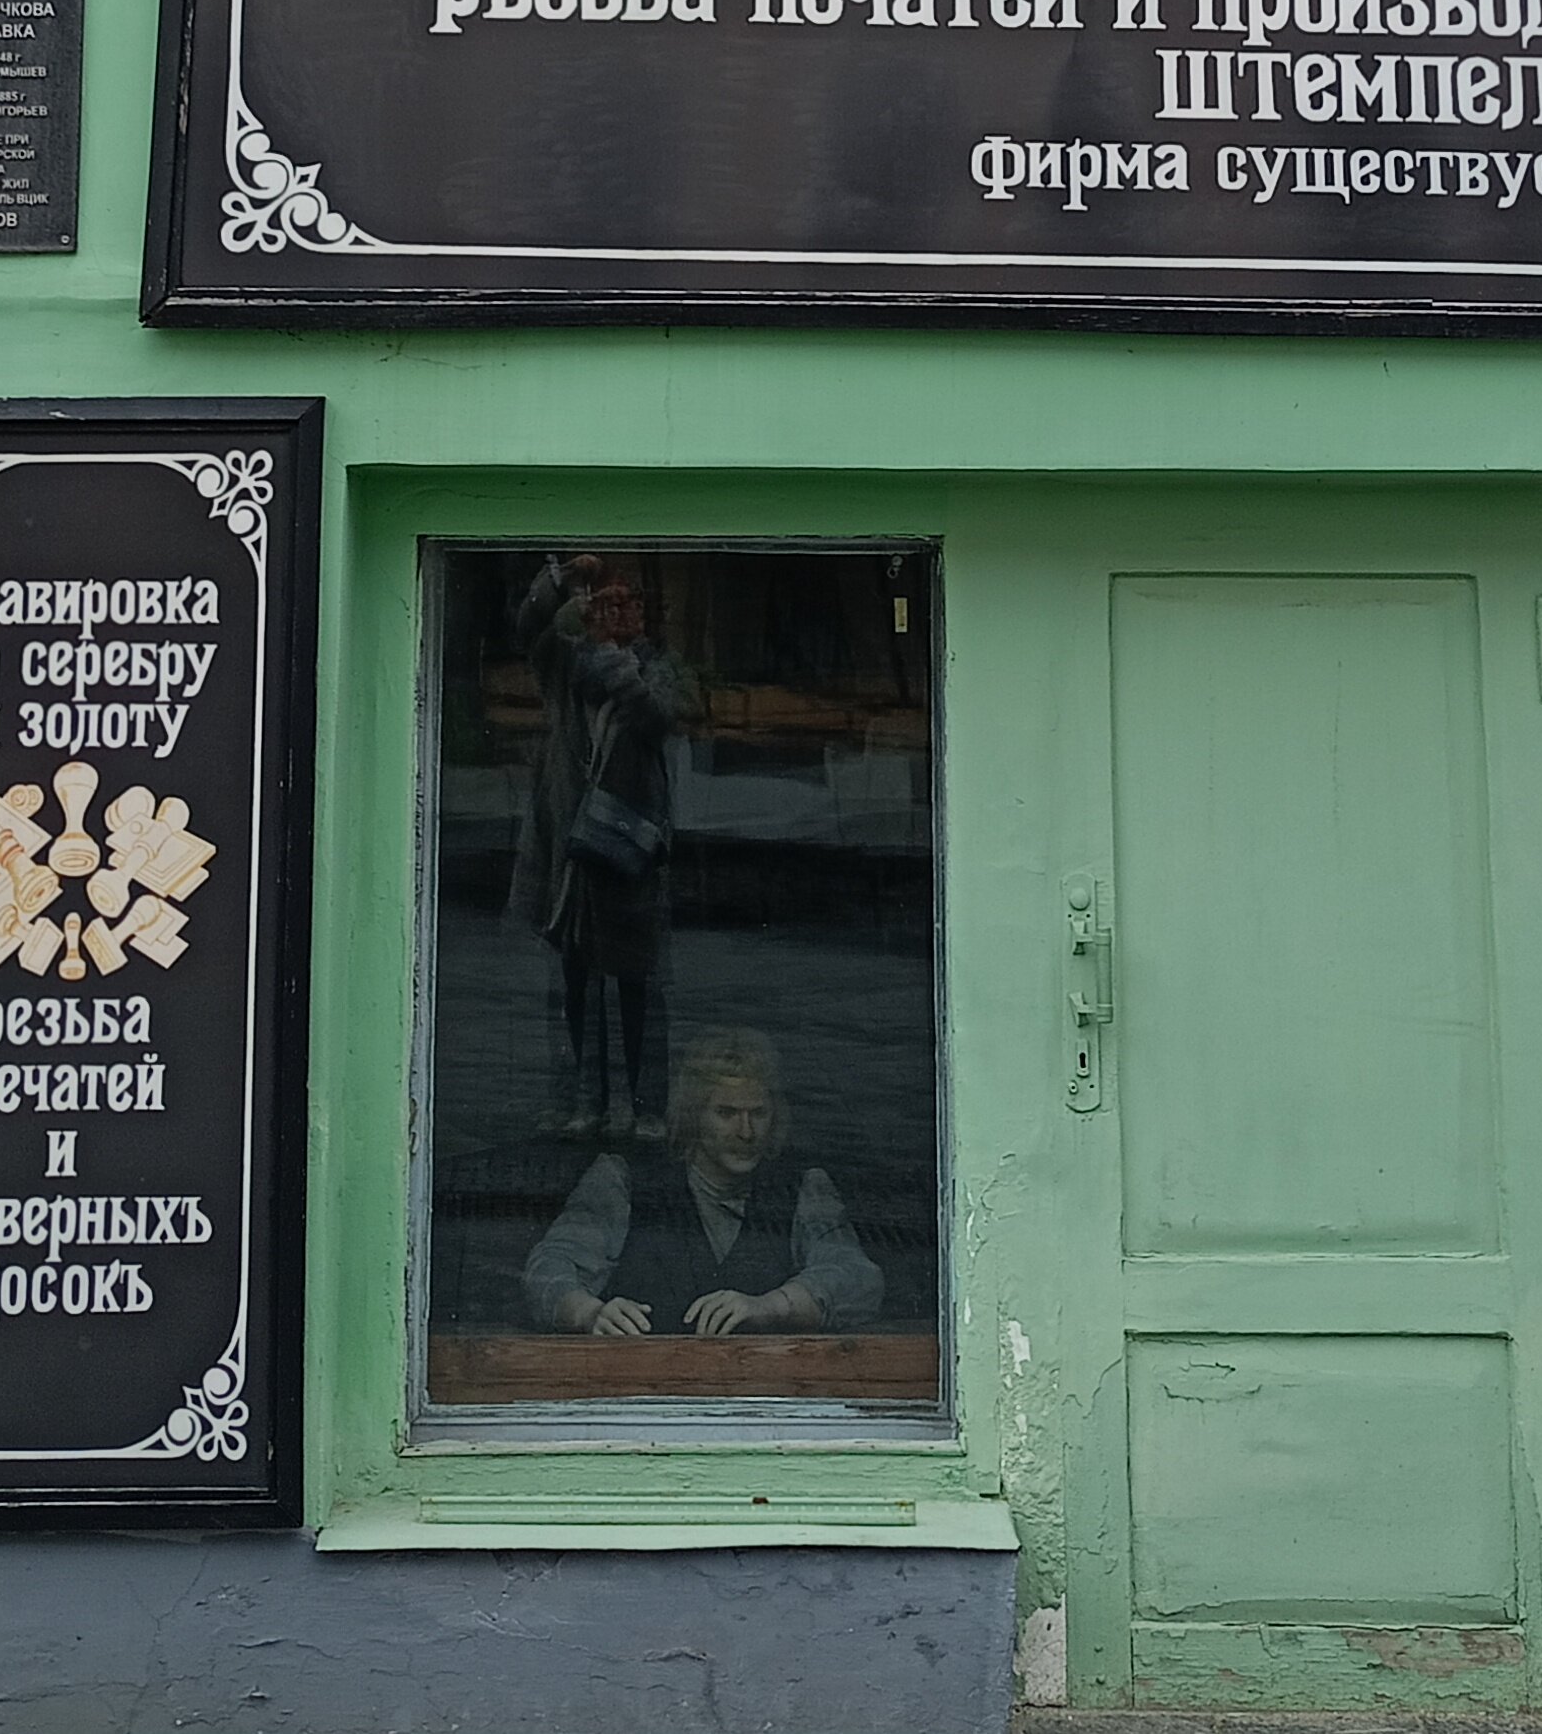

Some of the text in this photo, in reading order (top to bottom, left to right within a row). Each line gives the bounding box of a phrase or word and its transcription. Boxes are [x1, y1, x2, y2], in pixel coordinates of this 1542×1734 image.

[5, 134, 30, 145] ПРИ
[2, 179, 30, 189] ЖИЛ
[16, 193, 49, 205] ВЦИК
[19, 637, 218, 700] серебру
[17, 699, 190, 759] золоту
[45, 1127, 78, 1177] и
